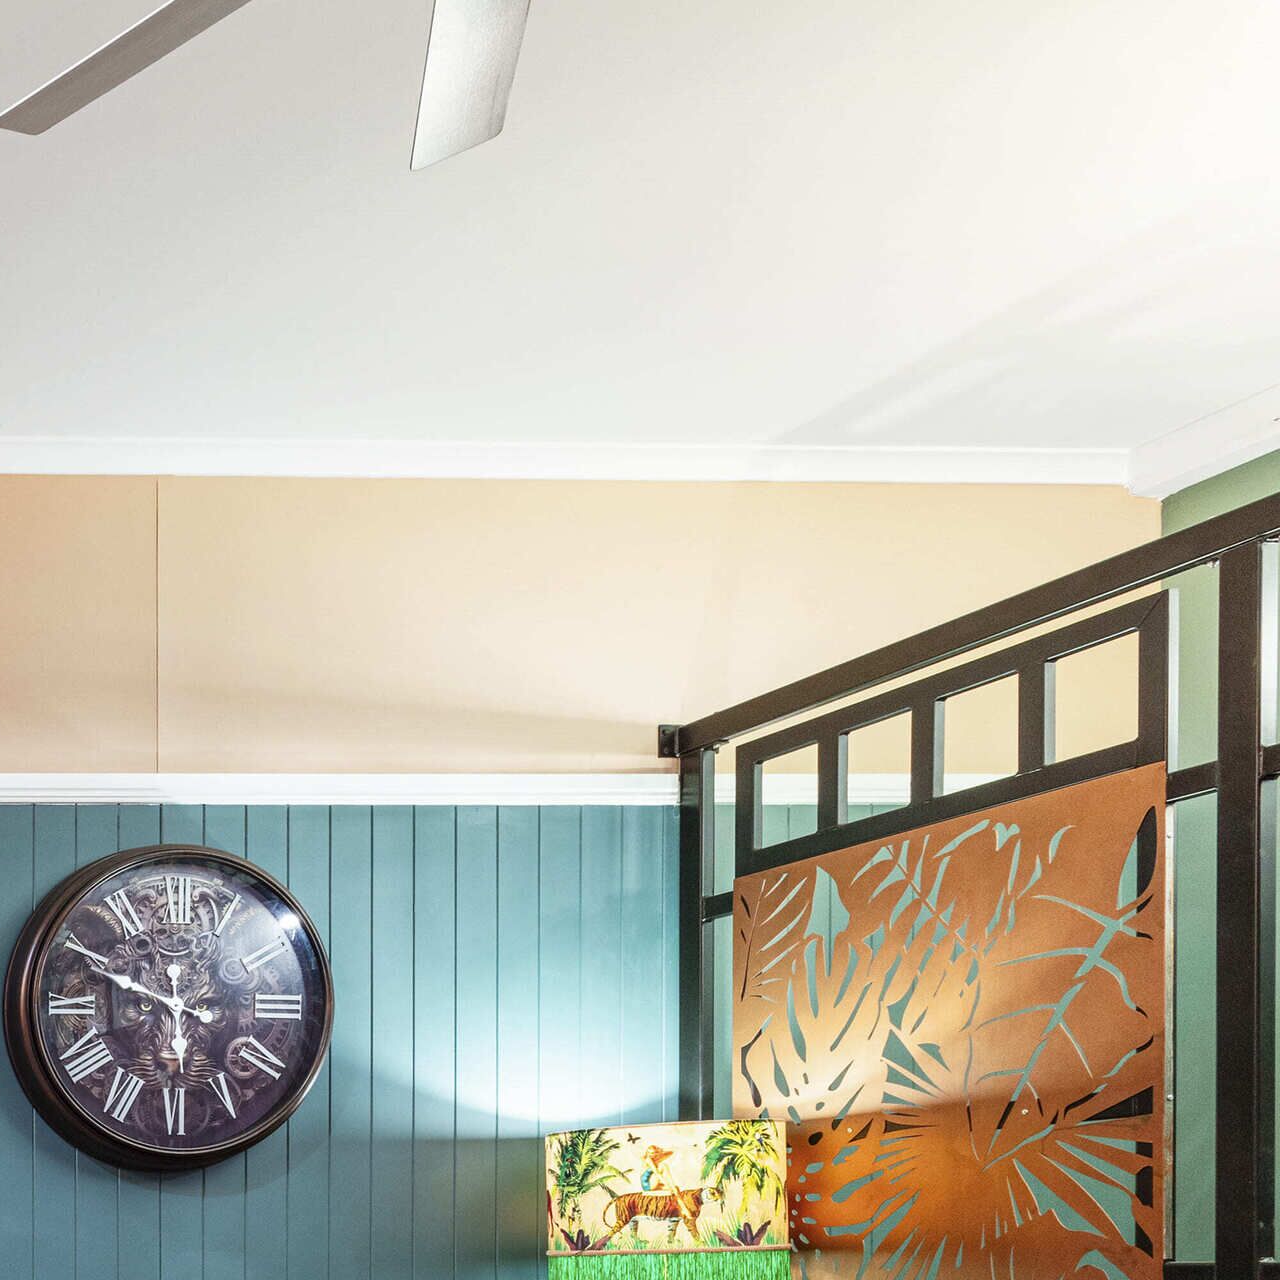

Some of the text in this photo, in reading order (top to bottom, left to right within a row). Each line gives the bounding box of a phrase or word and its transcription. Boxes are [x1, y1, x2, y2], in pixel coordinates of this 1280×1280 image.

[104, 890, 144, 939] XI
[162, 875, 192, 924] XII
[214, 894, 241, 937] I
[64, 932, 109, 970] X
[240, 935, 289, 973] II
[48, 991, 95, 1015] IX
[254, 993, 302, 1020] III
[59, 1027, 114, 1084] VIII
[239, 1034, 286, 1080] IV
[103, 1066, 145, 1123] VII
[163, 1087, 185, 1136] VI
[208, 1072, 236, 1119] V
